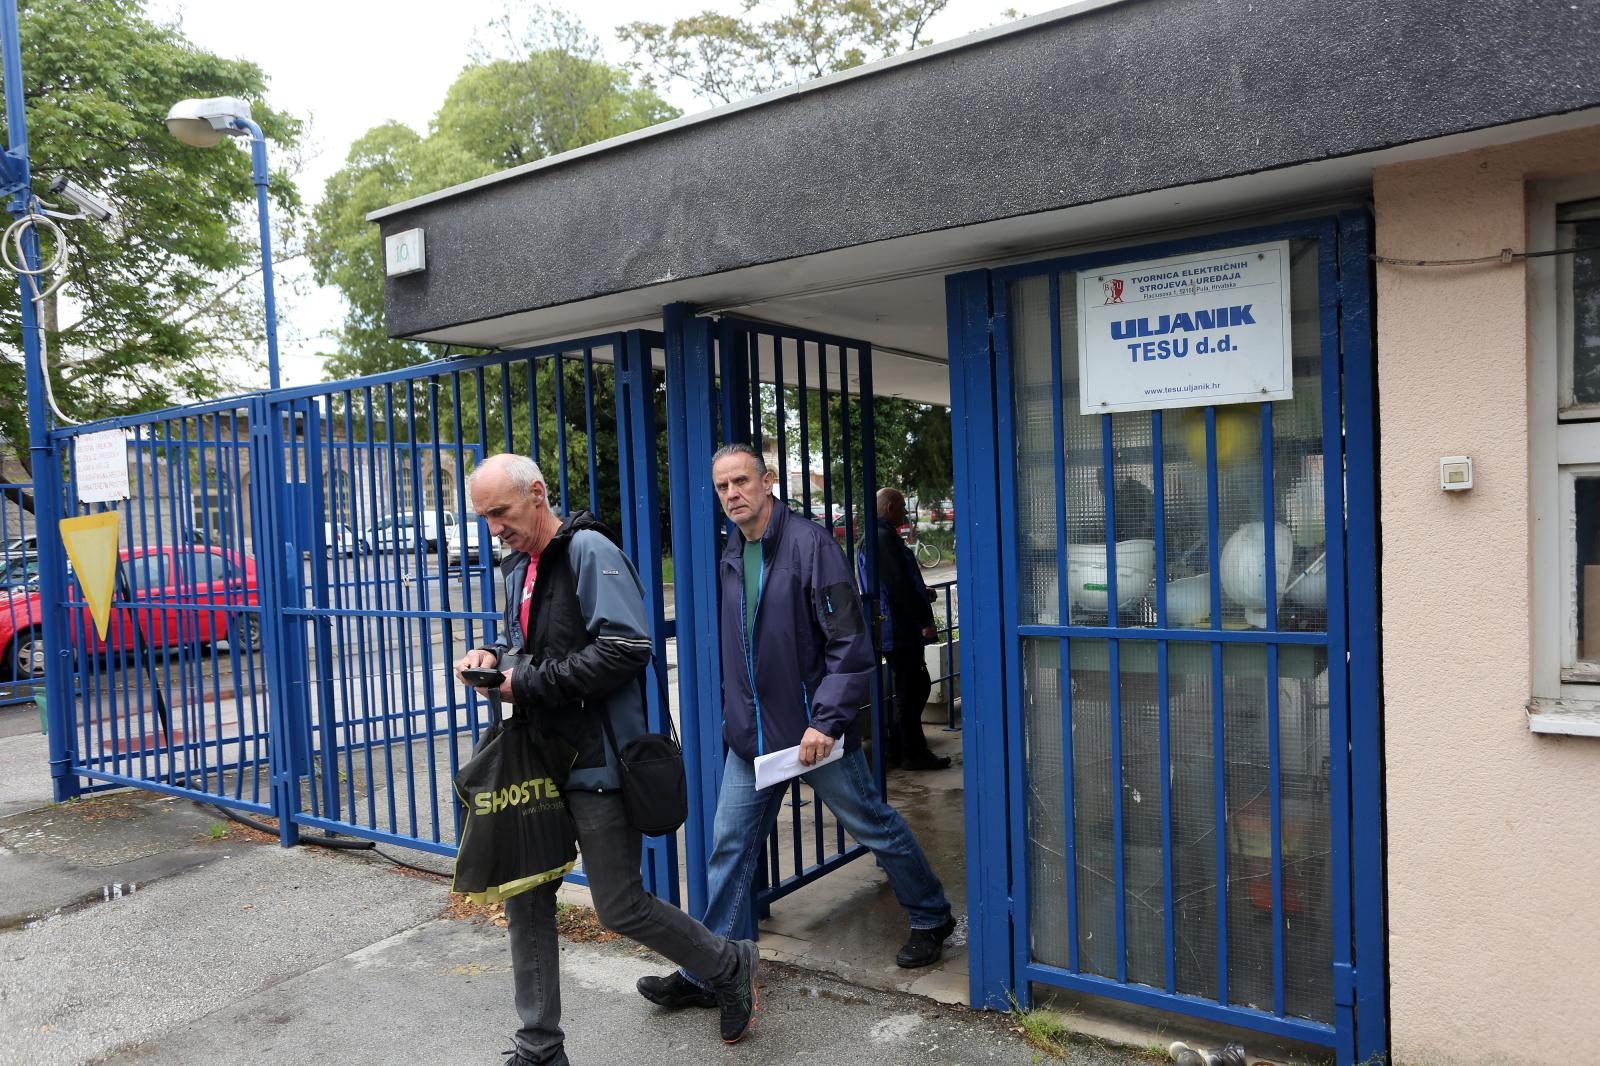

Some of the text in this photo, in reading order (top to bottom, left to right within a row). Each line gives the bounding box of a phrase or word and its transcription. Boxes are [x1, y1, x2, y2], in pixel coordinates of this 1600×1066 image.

[1131, 271, 1179, 285] TVORNICA
[1139, 279, 1188, 293] STROJEVA
[1110, 304, 1256, 340] ULJANIK
[1127, 334, 1238, 363] TESU d.d.
[1144, 381, 1221, 396] www.tesu.uljanik.hr
